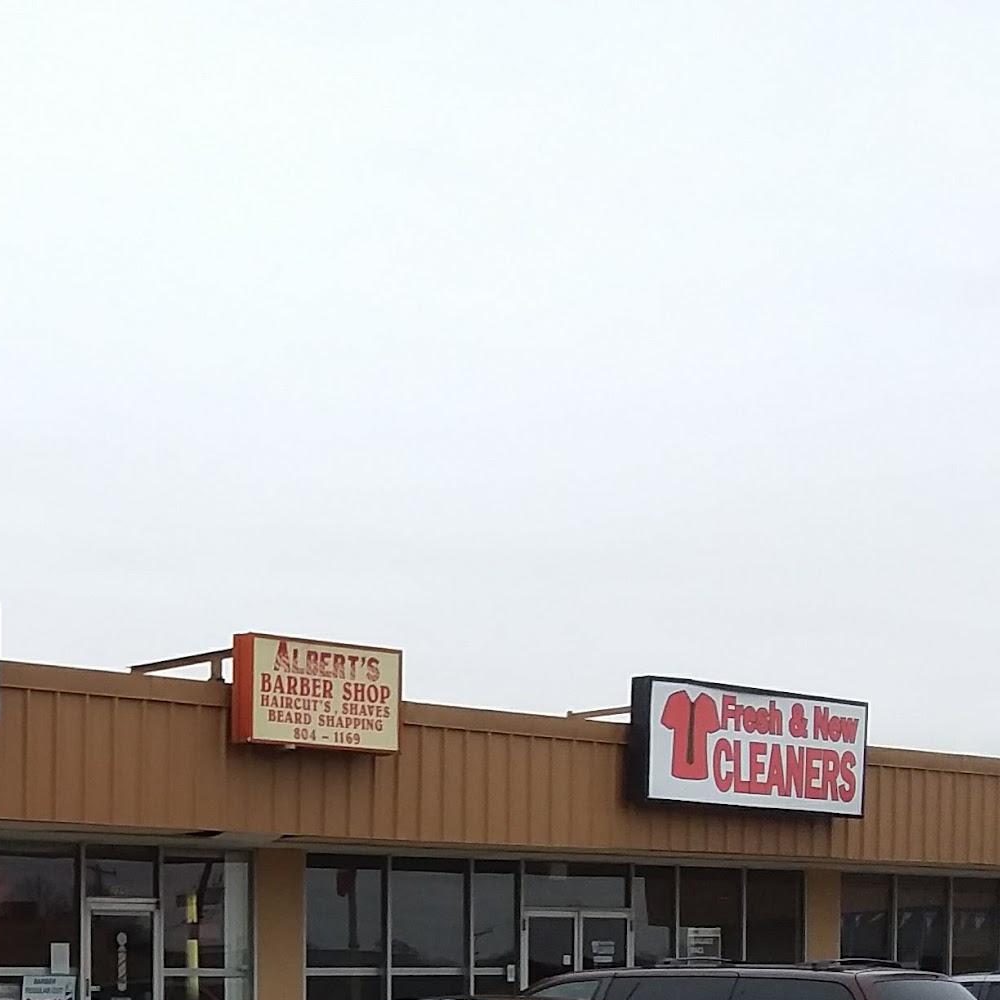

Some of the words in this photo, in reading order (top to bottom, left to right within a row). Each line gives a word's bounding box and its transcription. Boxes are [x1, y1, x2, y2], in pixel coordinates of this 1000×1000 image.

[273, 640, 381, 682] ALBERT'S
[260, 672, 334, 699] BARBER
[342, 681, 391, 704] SHOP
[268, 709, 312, 725] BEARD
[318, 714, 383, 732] SHAPPING
[341, 702, 391, 719] SHAVES
[721, 694, 782, 735] Fresh
[788, 703, 808, 739] &
[813, 706, 860, 744] New
[293, 727, 317, 741] 804
[333, 731, 361, 745] 1169
[712, 737, 857, 803] CLEANERS
